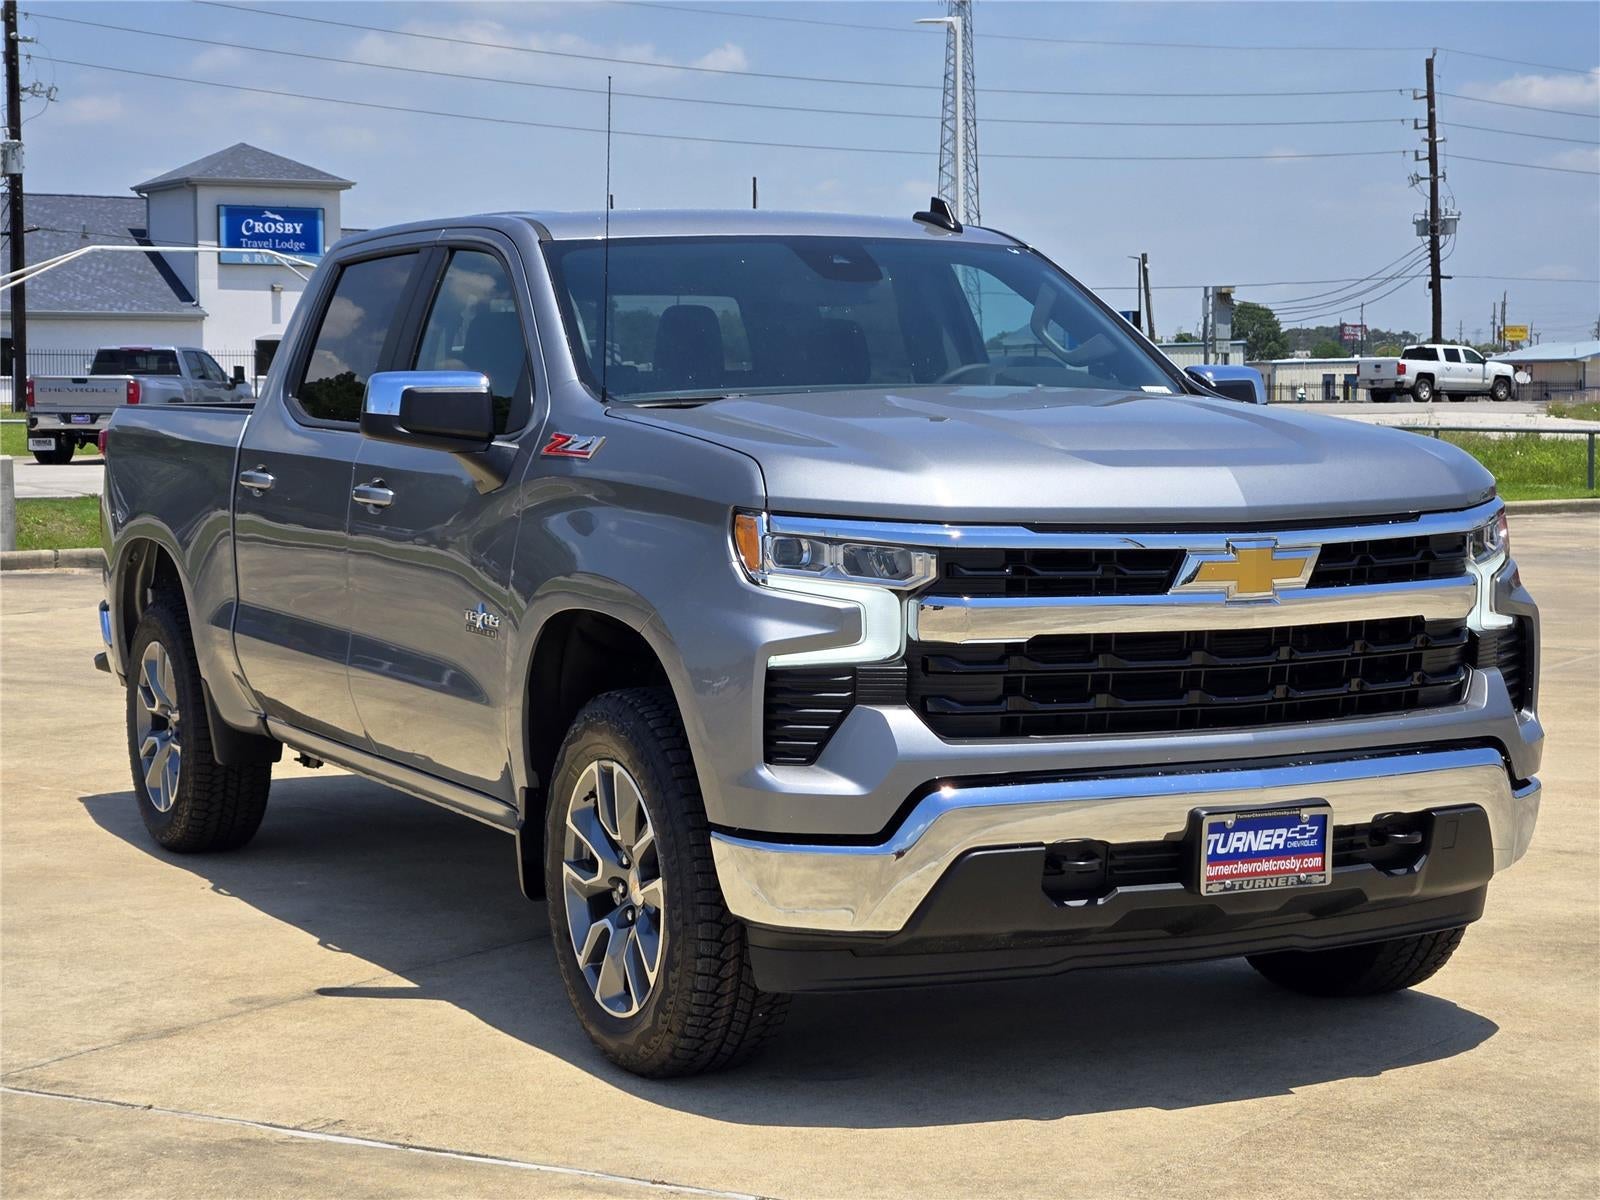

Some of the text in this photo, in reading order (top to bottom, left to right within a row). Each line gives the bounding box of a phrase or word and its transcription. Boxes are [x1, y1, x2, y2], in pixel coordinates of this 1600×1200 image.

[241, 219, 303, 235] CROSBY
[241, 238, 306, 251] Travel Lodge
[242, 254, 250, 263] &
[254, 254, 269, 264] RV
[541, 432, 606, 459] Z71
[464, 607, 499, 629] TEXAS
[1207, 828, 1289, 855] TURNER
[1287, 839, 1318, 848] CHEVROLET
[1206, 857, 1322, 877] turnerchevroletcrosby.com
[1232, 876, 1298, 890] TURNER
